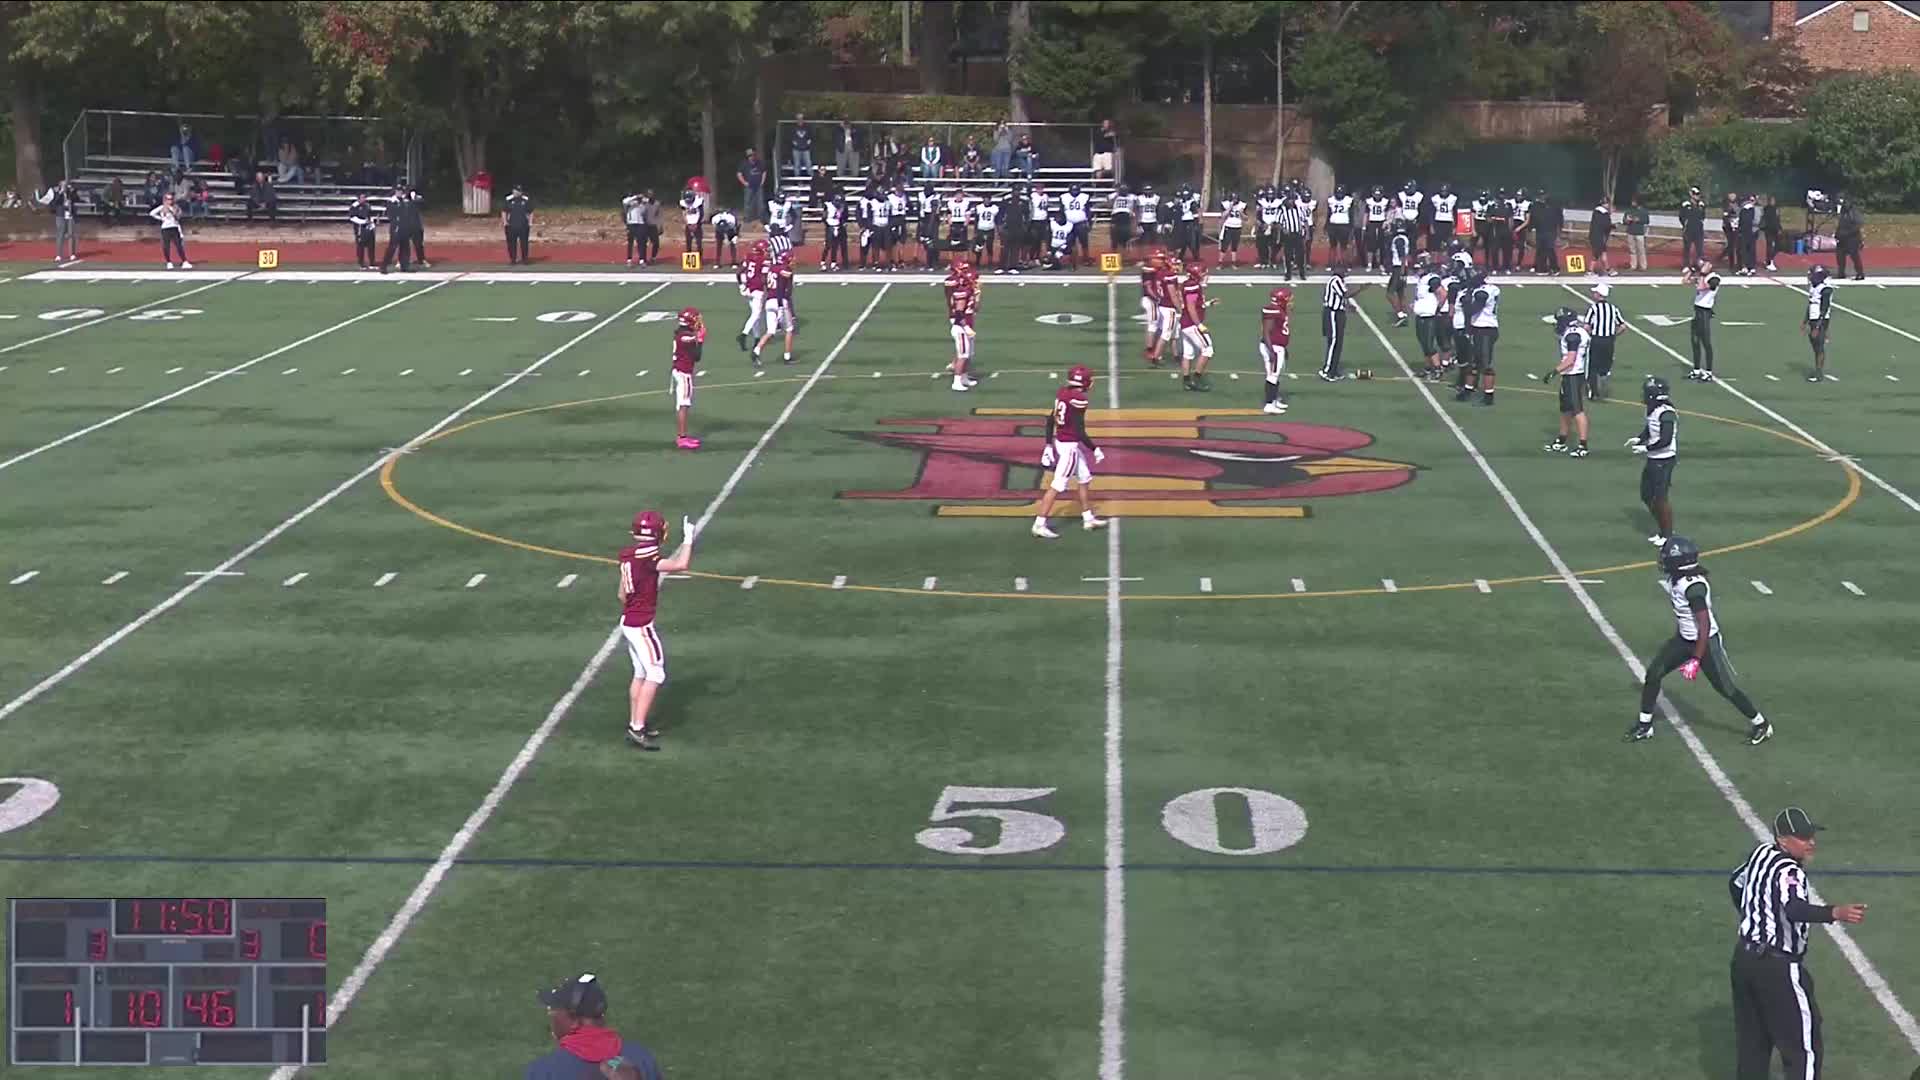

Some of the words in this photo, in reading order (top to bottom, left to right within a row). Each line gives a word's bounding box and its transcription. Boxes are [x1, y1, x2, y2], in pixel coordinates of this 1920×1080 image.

[262, 250, 275, 266] 30
[685, 254, 697, 269] 40
[1569, 256, 1583, 271] 40
